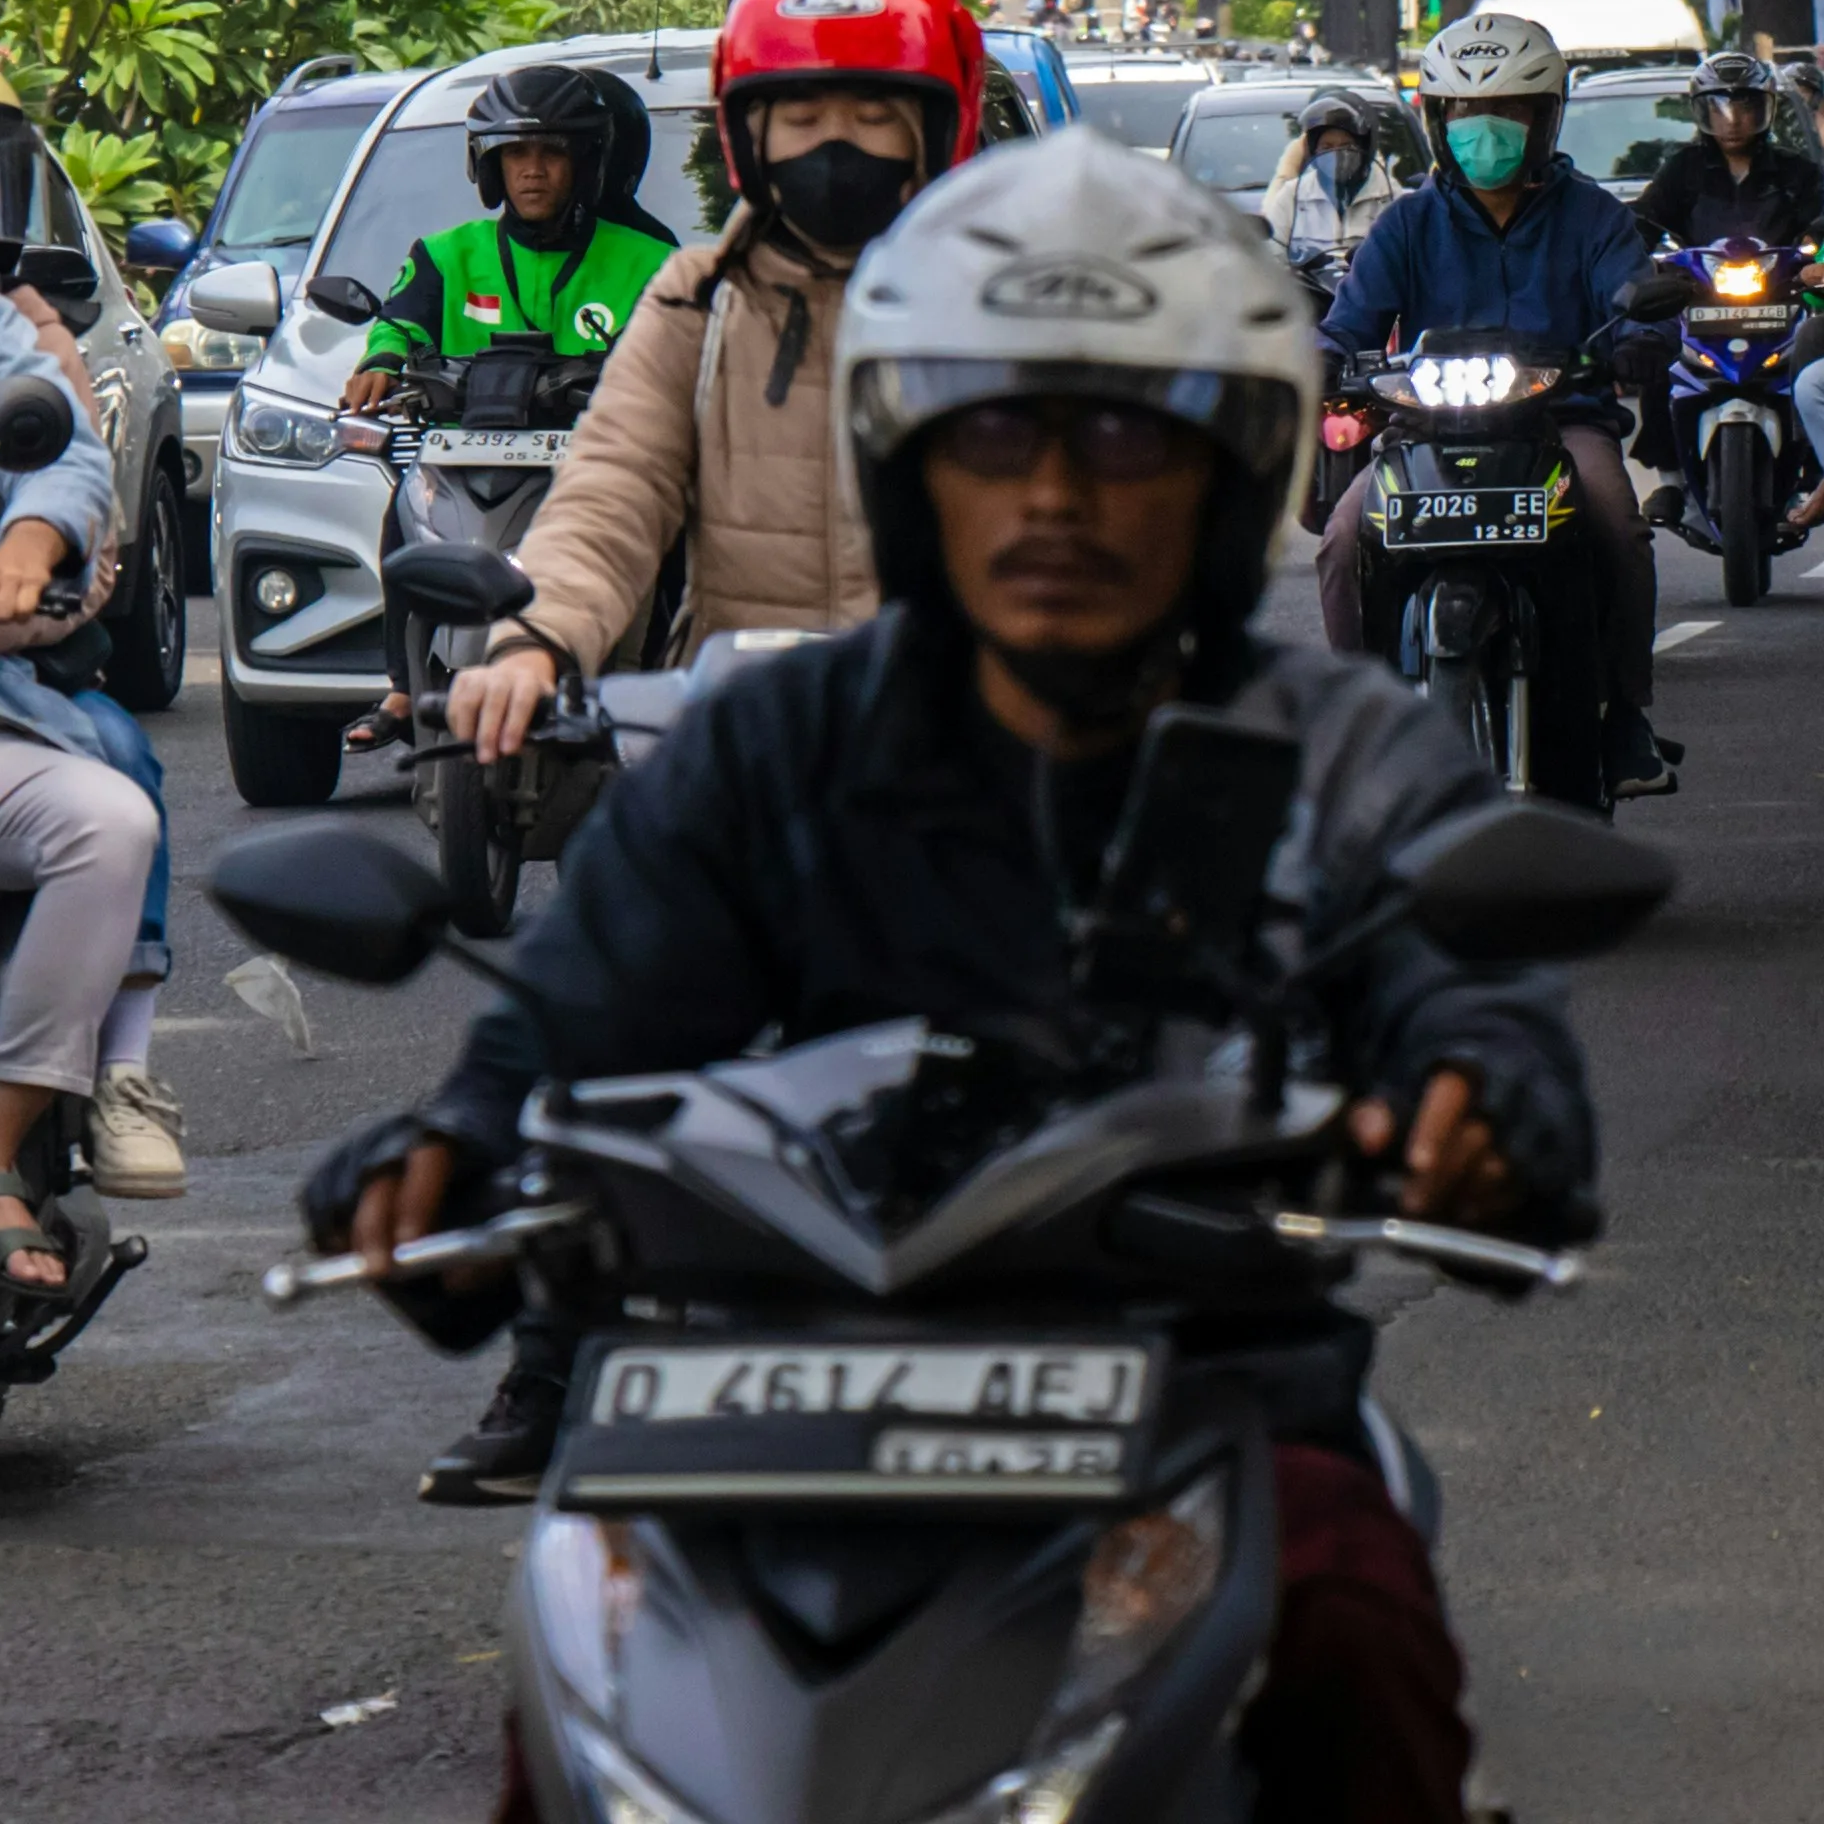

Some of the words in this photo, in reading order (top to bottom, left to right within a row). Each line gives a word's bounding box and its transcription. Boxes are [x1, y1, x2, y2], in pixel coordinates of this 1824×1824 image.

[461, 432, 518, 447] 2392
[1388, 497, 1403, 520] D
[1417, 495, 1478, 518] 2026
[1513, 492, 1545, 517] EE
